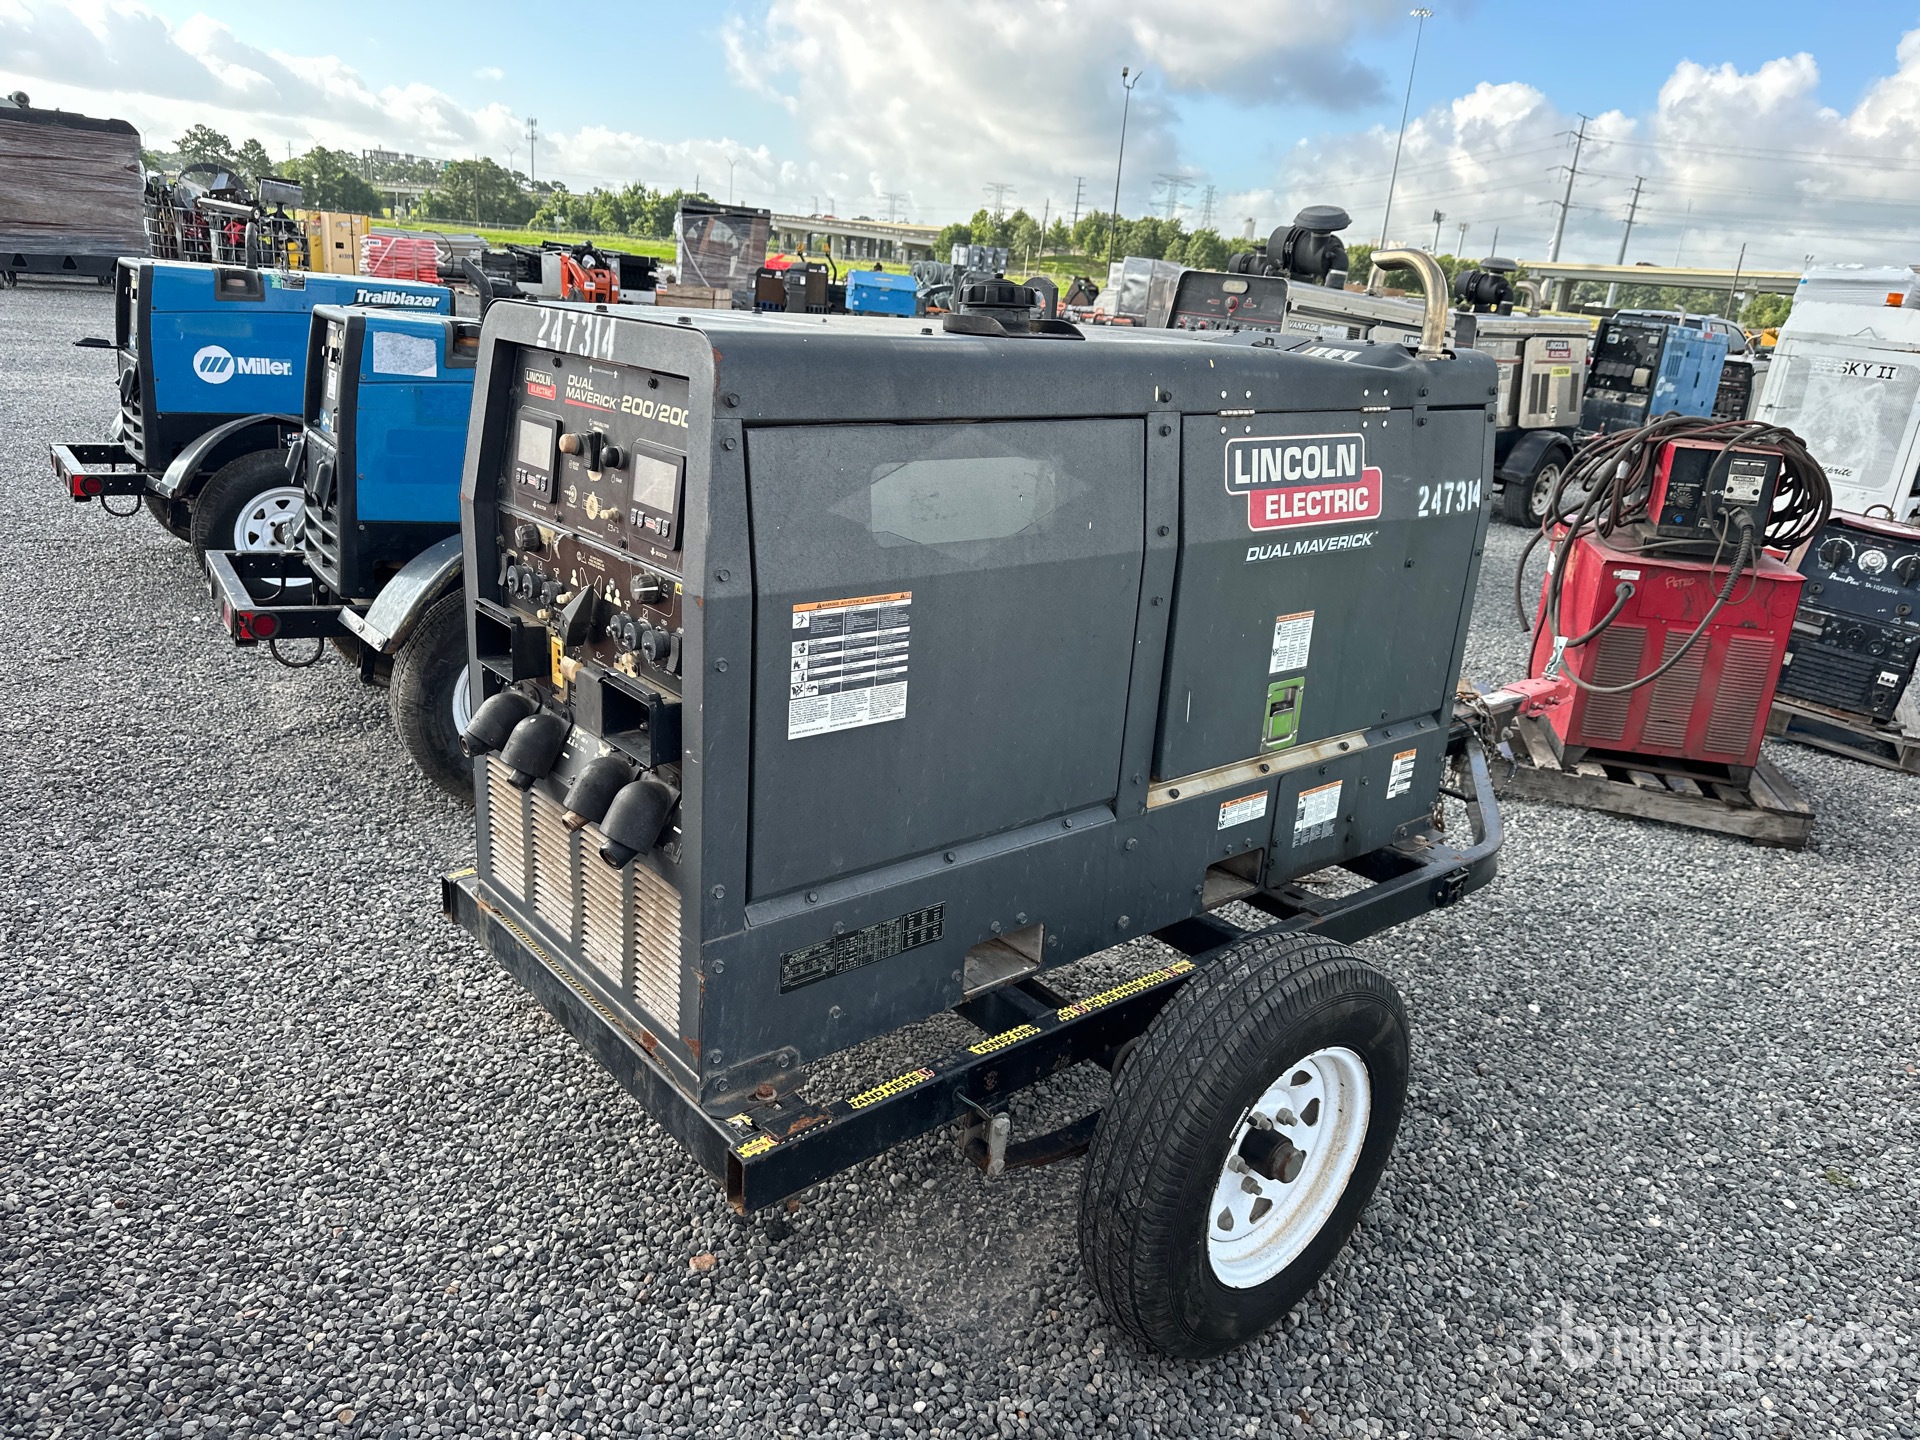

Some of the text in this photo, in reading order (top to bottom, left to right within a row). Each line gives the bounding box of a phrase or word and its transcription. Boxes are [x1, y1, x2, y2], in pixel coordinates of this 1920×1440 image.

[356, 289, 440, 307] Trailblazer
[536, 307, 616, 360] 247314
[1288, 320, 1320, 332] VANTAGE
[525, 371, 552, 386] LINCOLN
[1876, 365, 1897, 379] II
[530, 386, 553, 398] ELECTRIC
[567, 374, 594, 391] DUAL
[565, 386, 617, 410] MAVERICK
[1234, 443, 1357, 485] LINCOLN
[1265, 486, 1369, 520] ELECTRIC
[1417, 478, 1481, 517] 247314
[1245, 532, 1373, 562] DUAL MAVERICK
[1085, 999, 1102, 1009] NO
[1102, 993, 1115, 1003] SE
[1116, 982, 1141, 996] PARE
[1142, 973, 1165, 986] AQUI
[975, 1034, 1015, 1052] TENEZ
[884, 1073, 921, 1093] HERE
